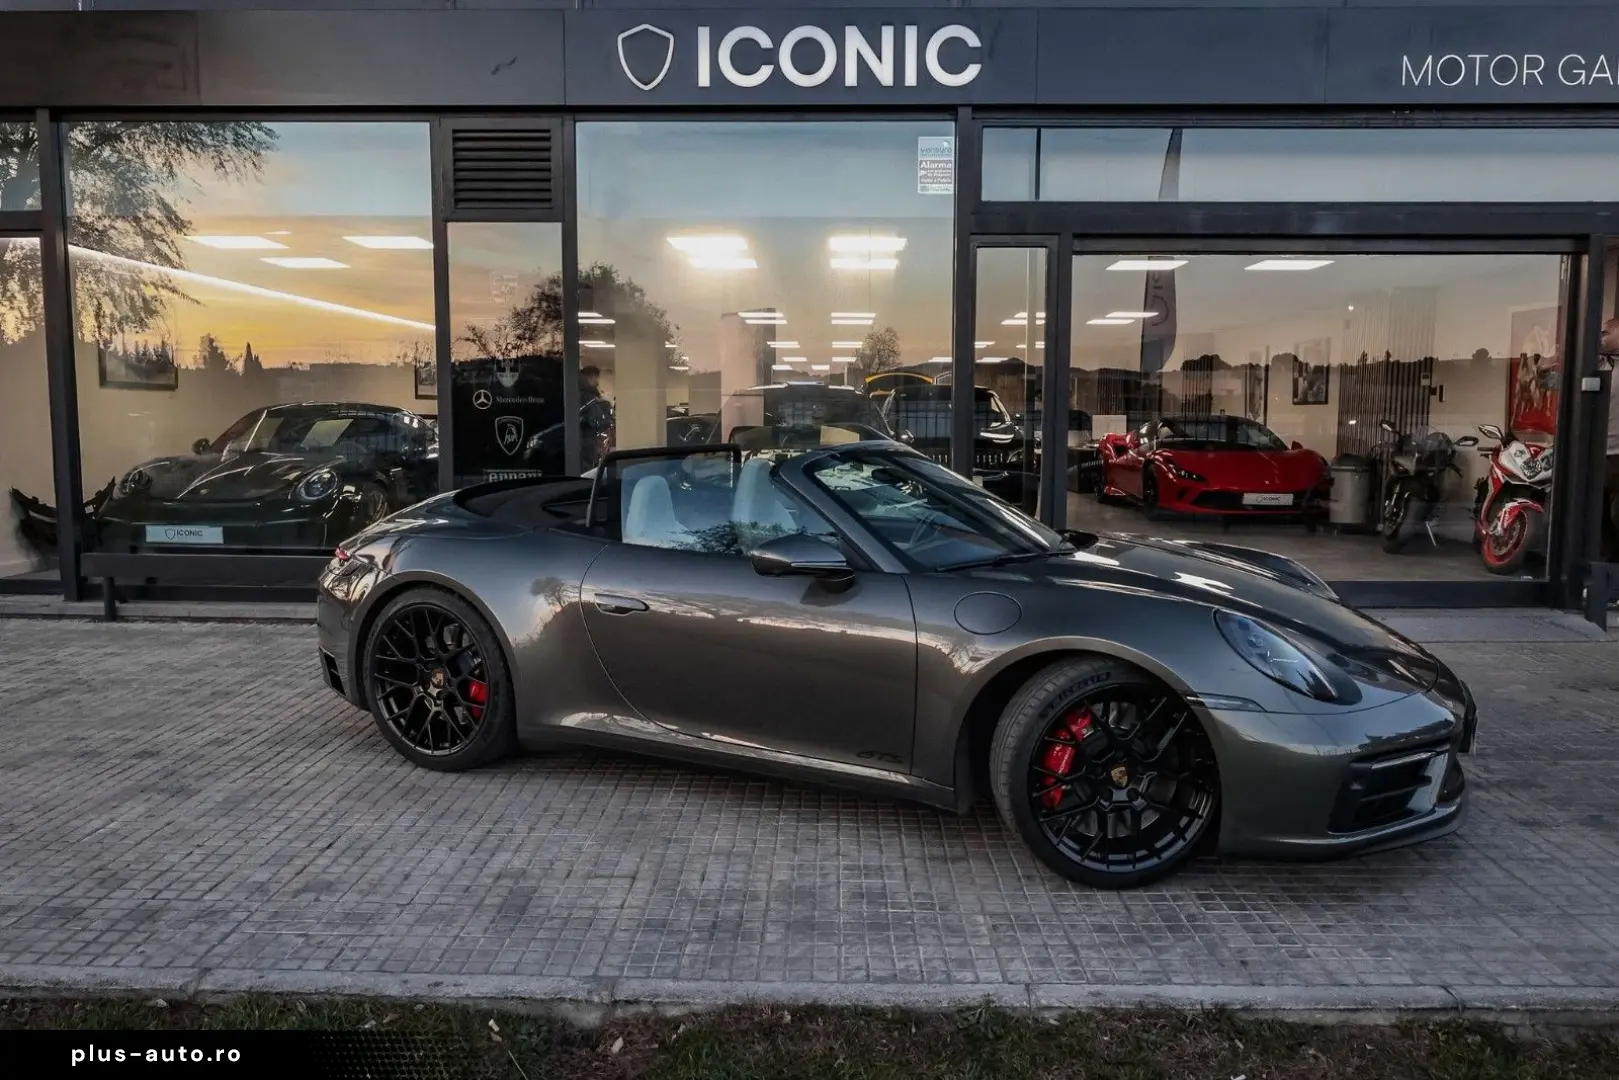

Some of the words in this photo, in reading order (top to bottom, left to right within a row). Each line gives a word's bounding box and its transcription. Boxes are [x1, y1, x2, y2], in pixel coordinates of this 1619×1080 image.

[697, 24, 982, 88] ICONIC
[1401, 54, 1545, 87] MOTOR
[1557, 54, 1619, 87] GA
[920, 161, 952, 169] Alarma
[176, 528, 203, 537] ICONIC
